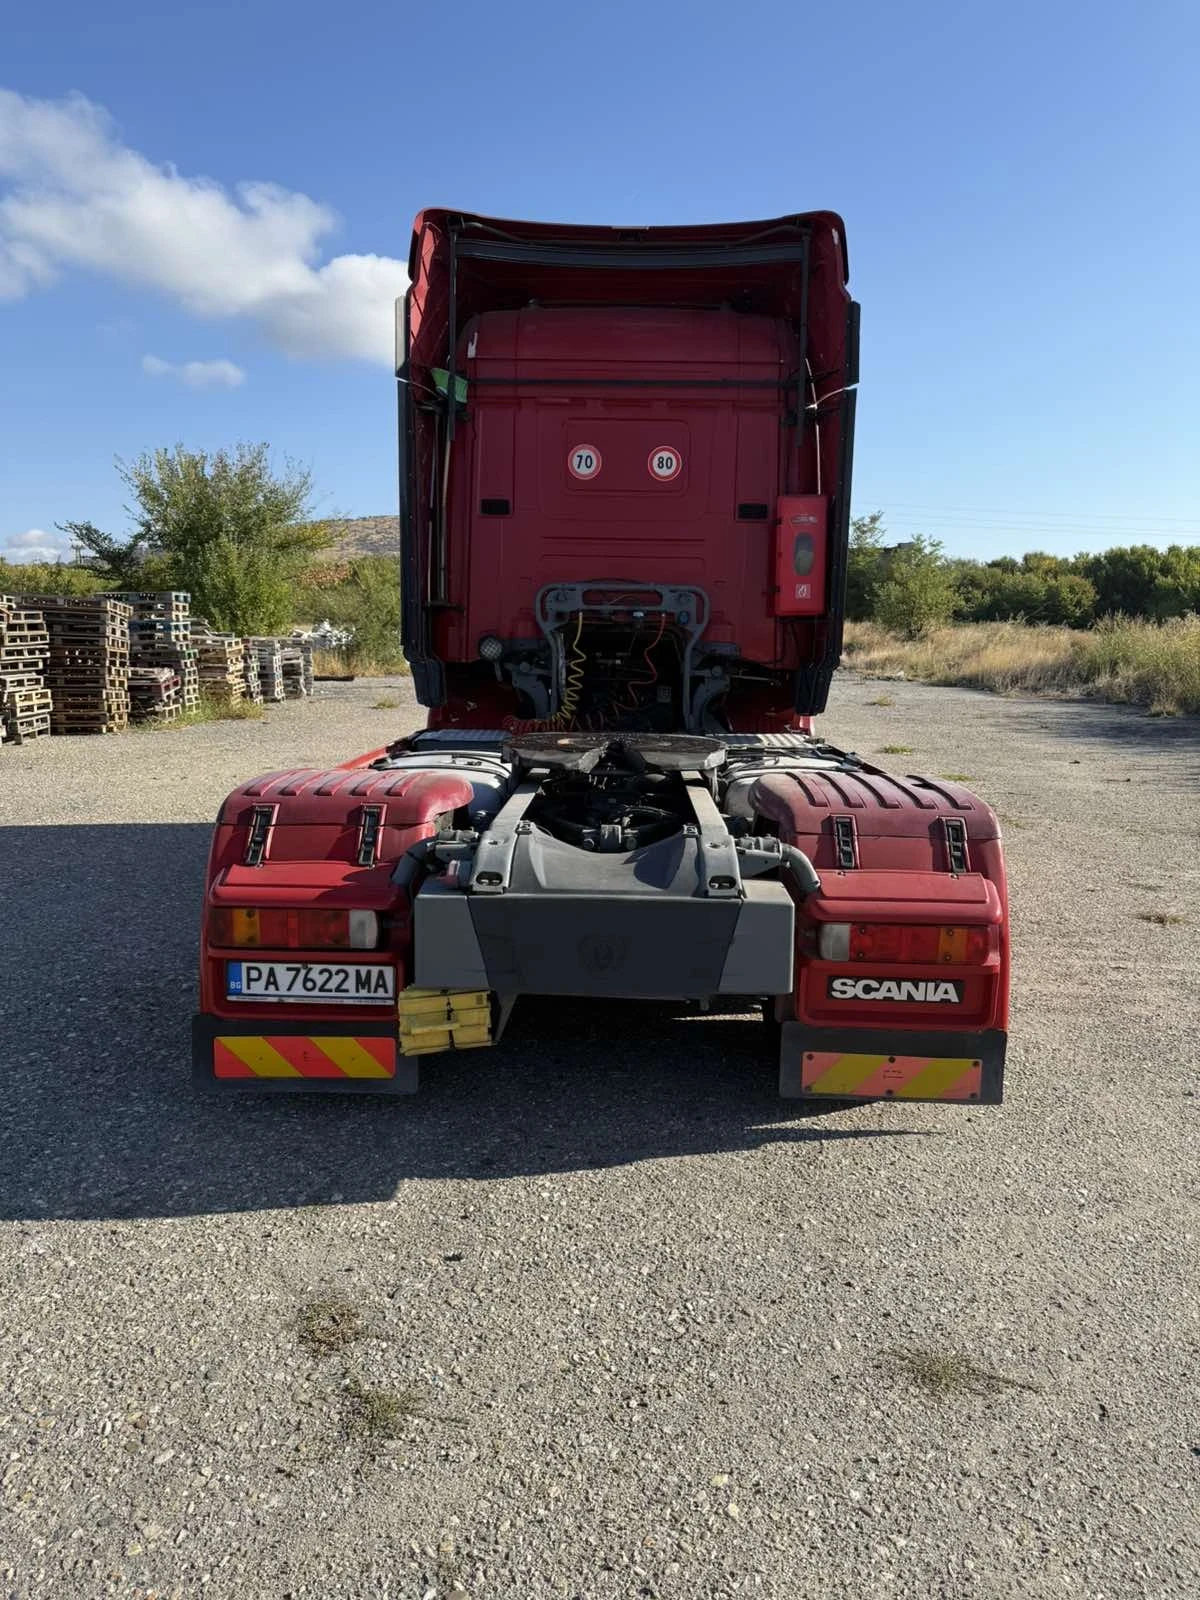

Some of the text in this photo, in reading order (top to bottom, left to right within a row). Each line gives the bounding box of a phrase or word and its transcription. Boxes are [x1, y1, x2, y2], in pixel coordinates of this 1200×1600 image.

[576, 454, 593, 469] 70
[657, 456, 673, 469] 80
[230, 981, 242, 989] BG
[831, 978, 959, 1002] SCANIA
